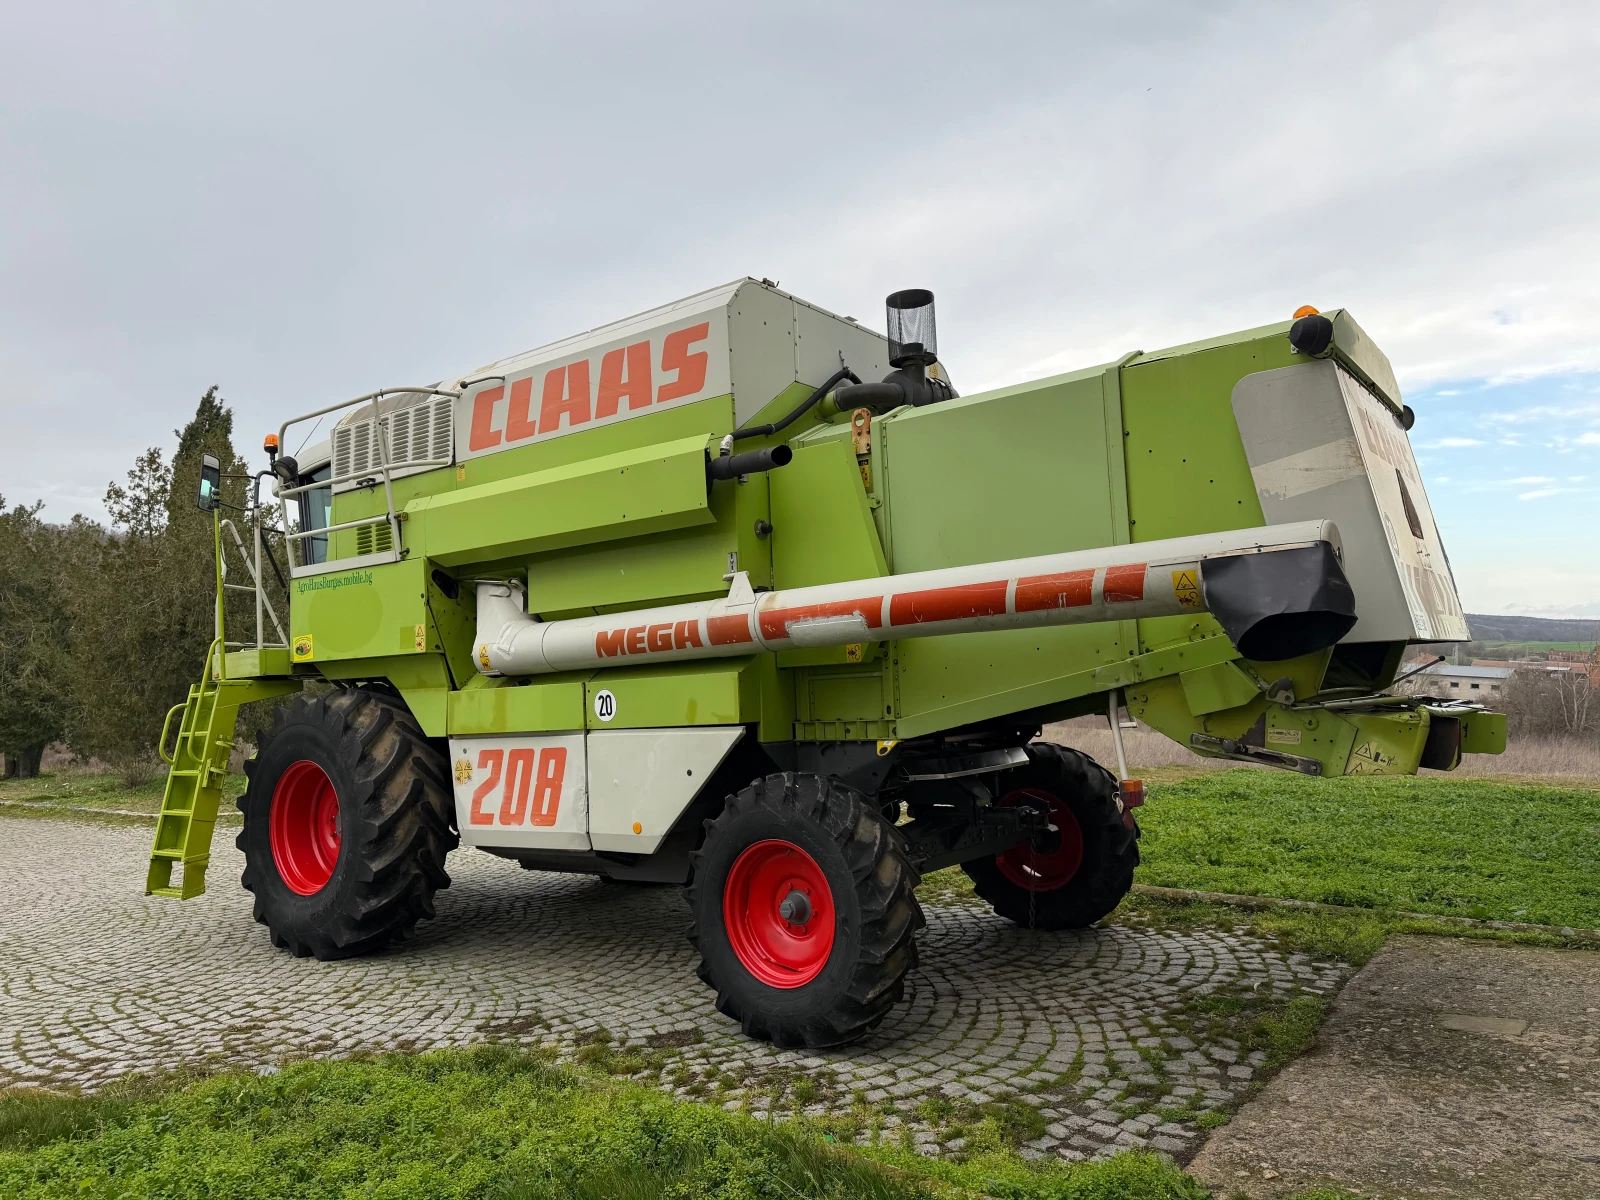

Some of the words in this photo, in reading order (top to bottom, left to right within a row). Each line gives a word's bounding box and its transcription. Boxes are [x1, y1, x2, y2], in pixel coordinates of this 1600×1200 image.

[469, 322, 709, 452] CLAAS
[596, 619, 704, 658] MEGA
[598, 694, 613, 717] 20
[470, 747, 568, 827] 208
